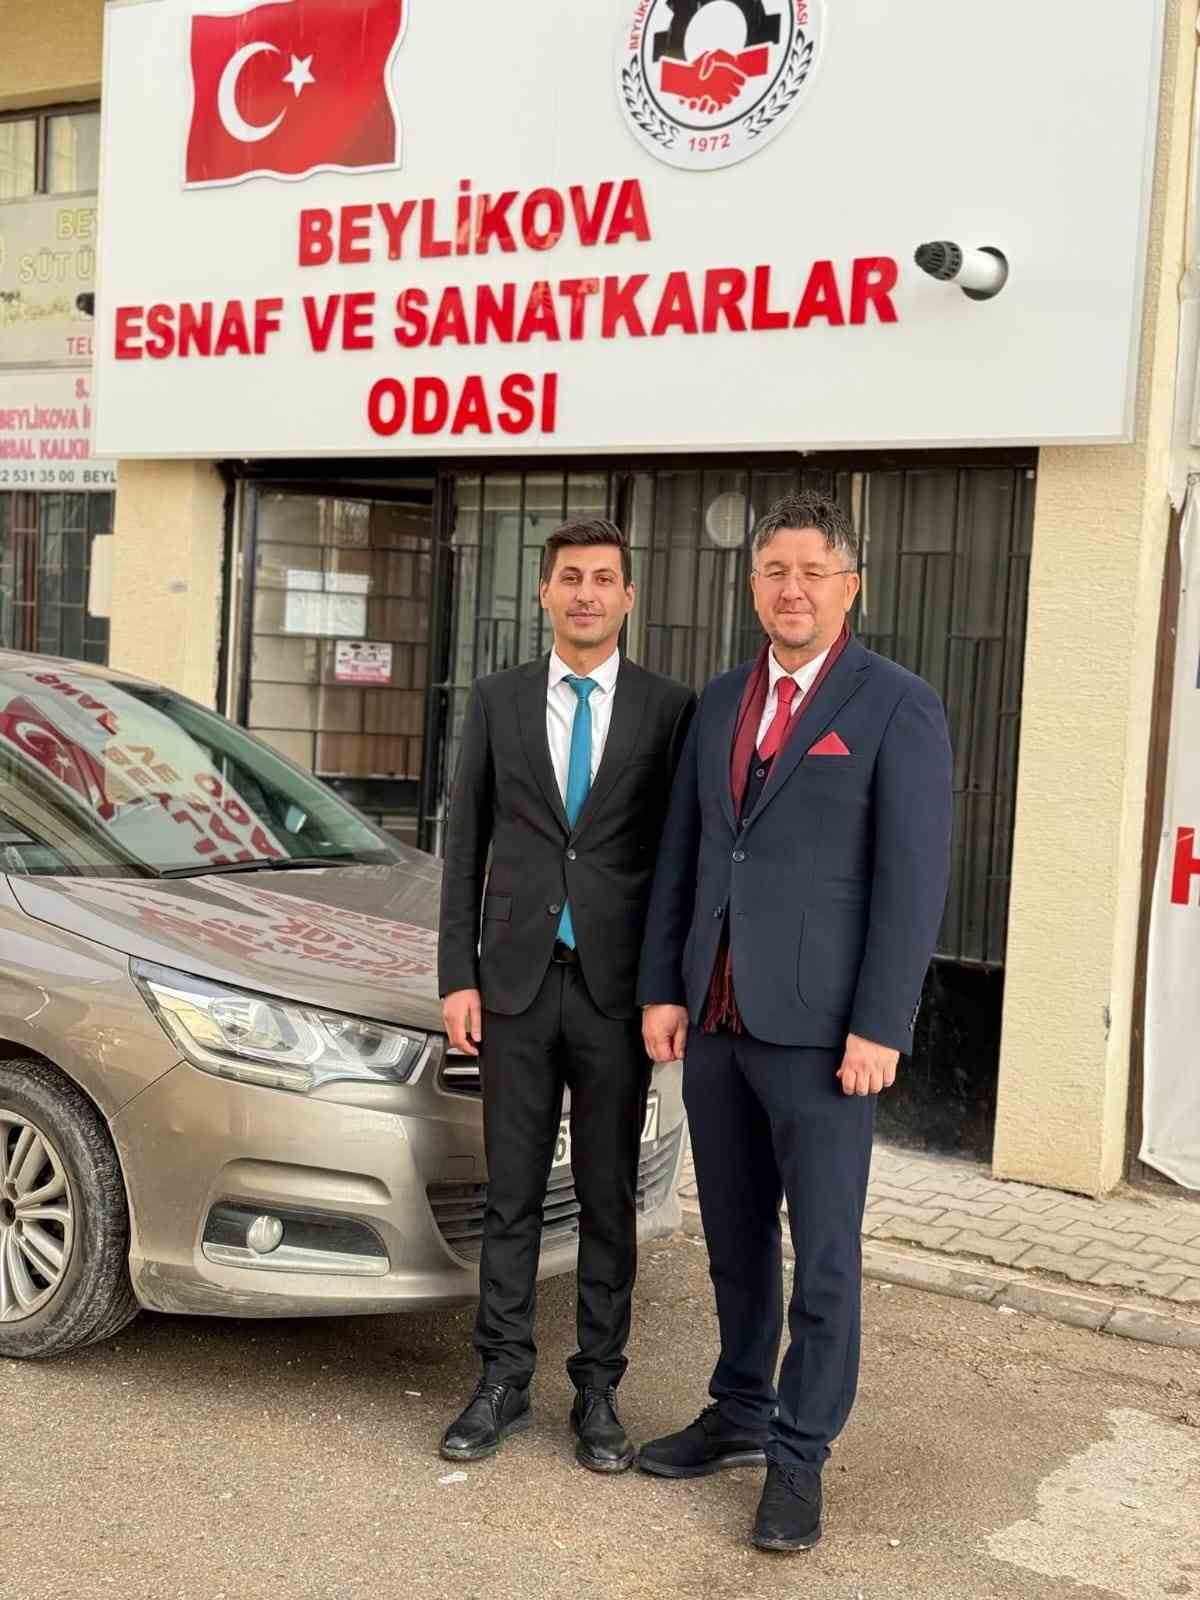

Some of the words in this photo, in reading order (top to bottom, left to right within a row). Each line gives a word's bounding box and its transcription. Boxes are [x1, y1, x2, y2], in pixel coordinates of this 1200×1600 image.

[688, 133, 731, 152] 1972
[56, 207, 97, 240] BE
[298, 179, 651, 267] BEYLİKOVA
[115, 297, 284, 360] ESNAF
[302, 292, 376, 352] VE
[394, 256, 899, 348] SANATKARLAR
[367, 373, 558, 436] ODASI
[40, 470, 56, 482] 35
[59, 470, 75, 482] 00
